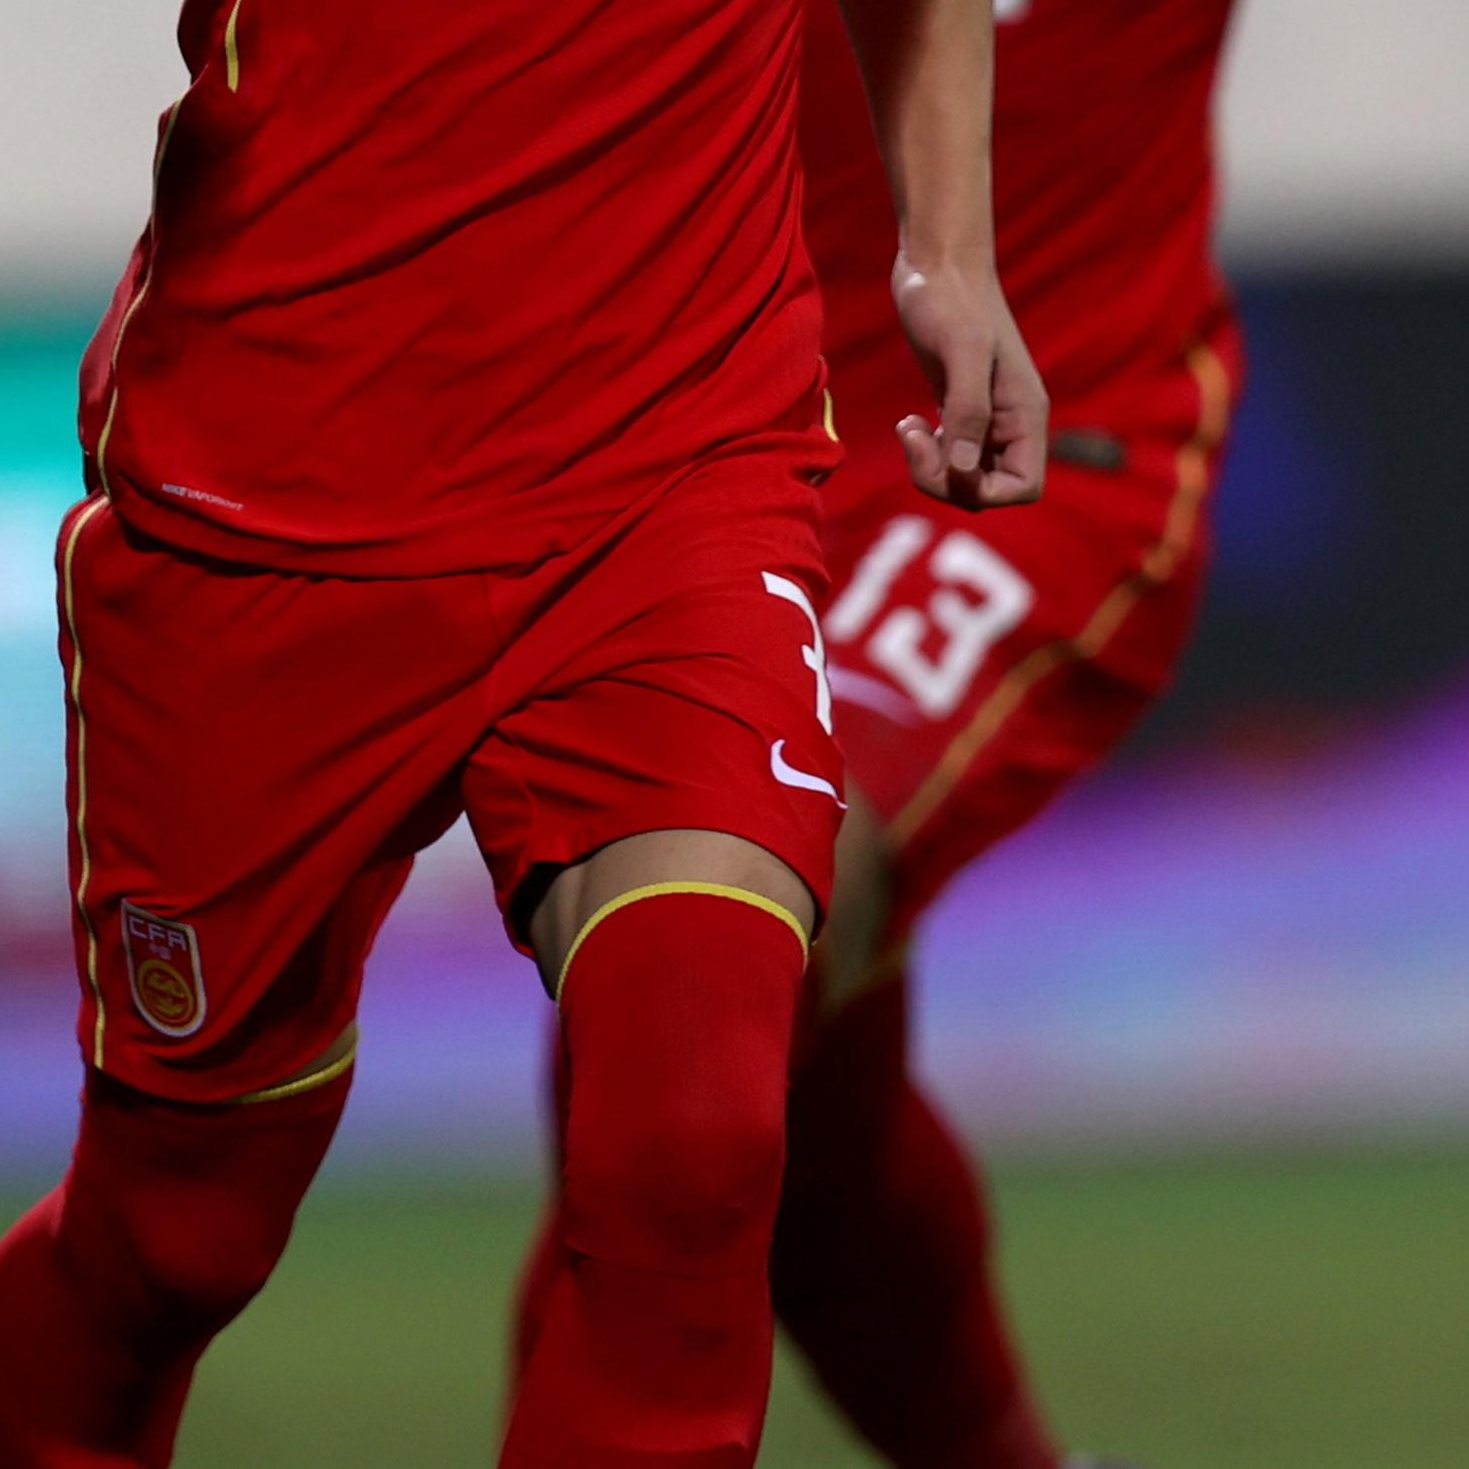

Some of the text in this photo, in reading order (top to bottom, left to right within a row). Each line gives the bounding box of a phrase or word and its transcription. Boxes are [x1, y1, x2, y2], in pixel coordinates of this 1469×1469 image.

[762, 571, 833, 735] 7
[825, 515, 1034, 718] 13
[129, 915, 187, 951] CFA
